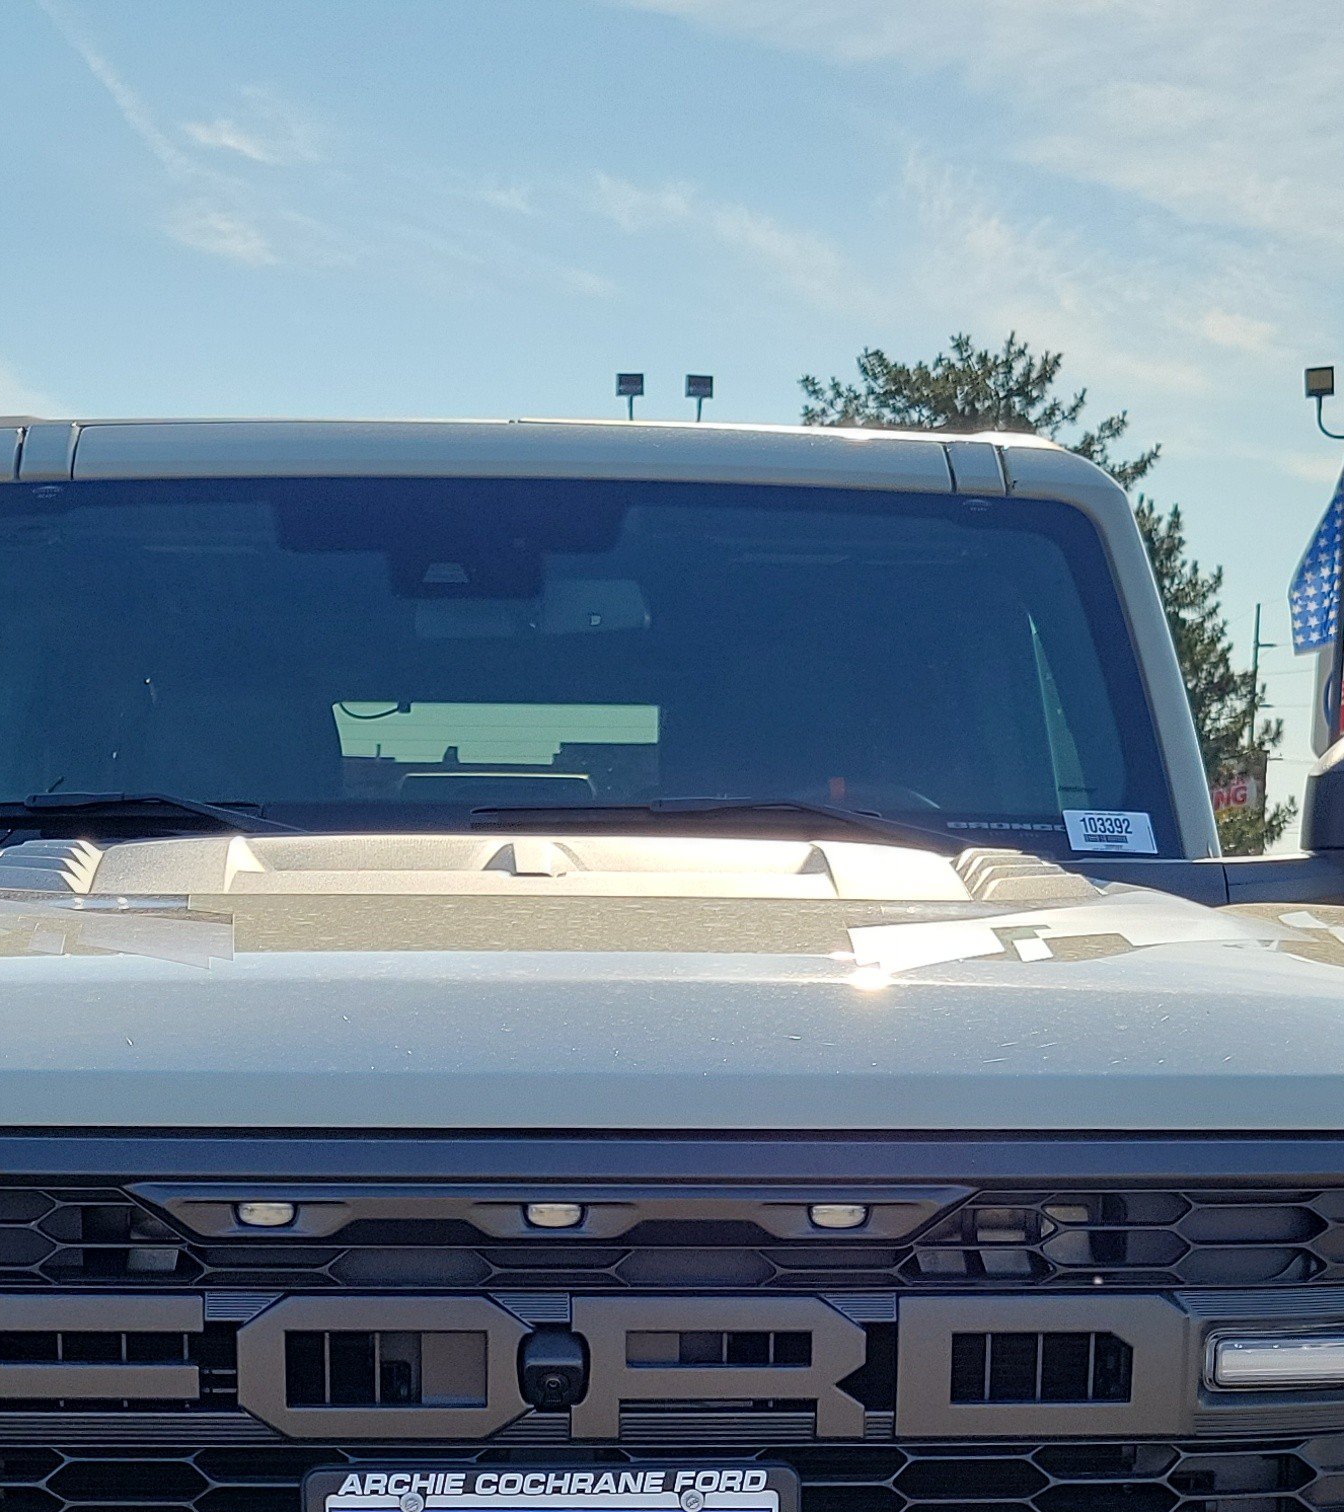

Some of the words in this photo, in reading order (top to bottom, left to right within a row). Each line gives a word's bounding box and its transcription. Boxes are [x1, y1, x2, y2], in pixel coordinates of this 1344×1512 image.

[1080, 817, 1133, 834] 103392
[337, 1473, 466, 1496] ARCHIE
[475, 1472, 666, 1496] COCHRANE
[674, 1470, 768, 1493] FORD
